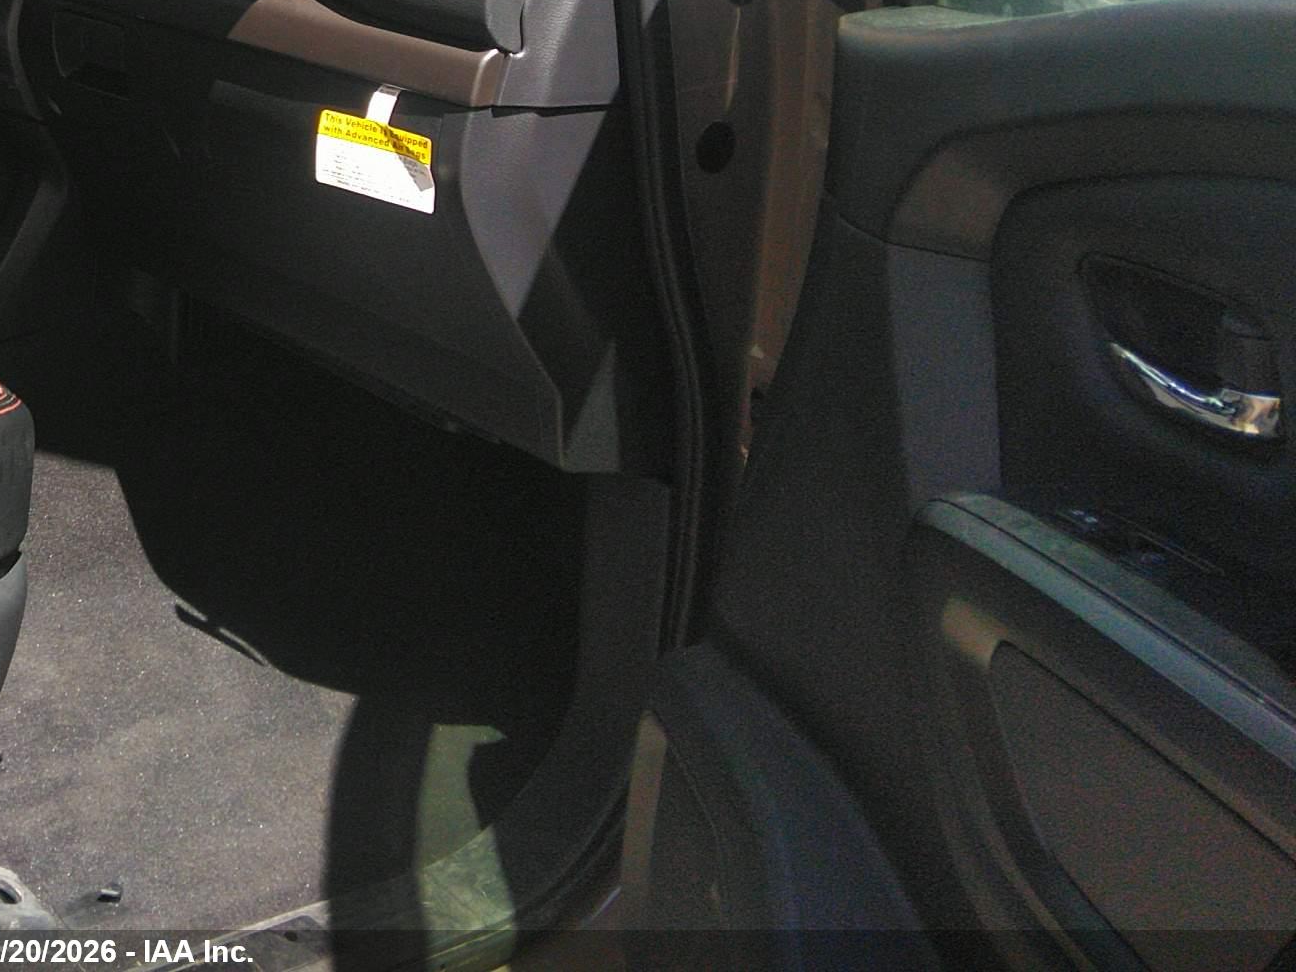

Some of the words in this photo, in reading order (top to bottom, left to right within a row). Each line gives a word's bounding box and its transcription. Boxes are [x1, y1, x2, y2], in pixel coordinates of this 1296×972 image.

[325, 113, 342, 124] This
[346, 118, 378, 133] Vehicle
[323, 125, 343, 135] with
[345, 130, 391, 147] Advanced
